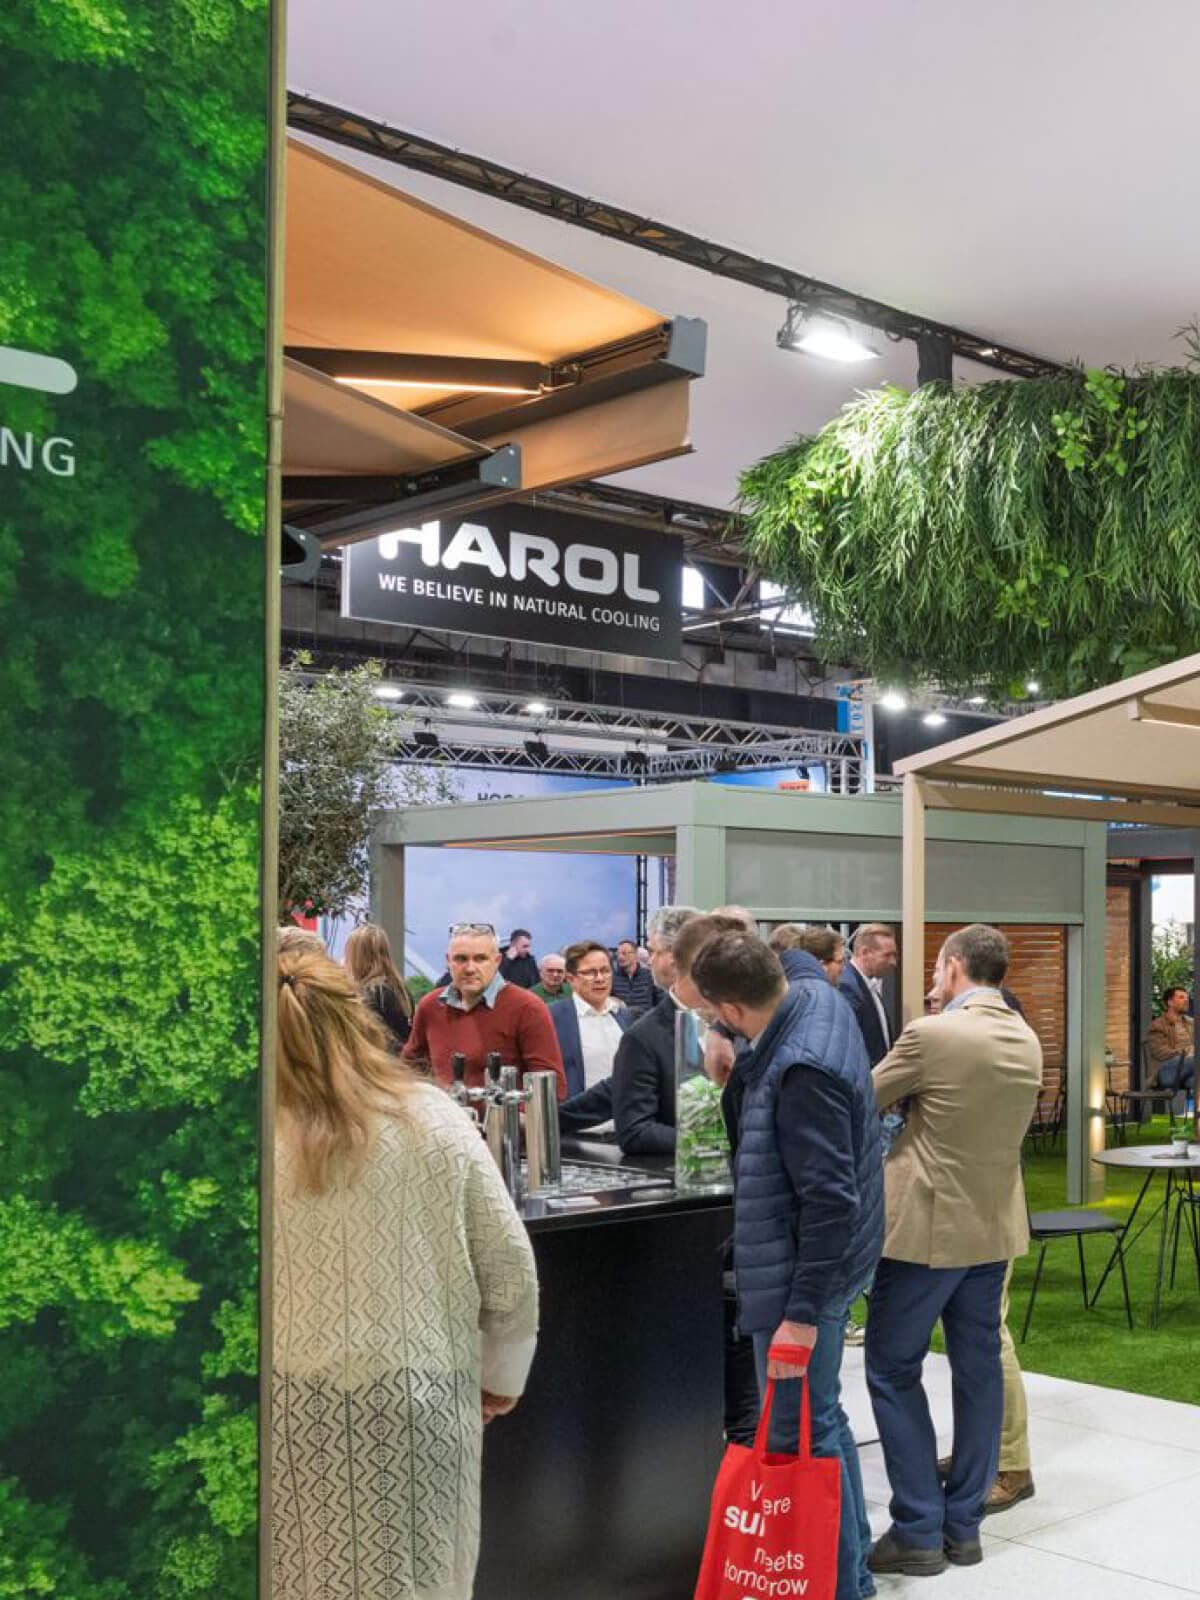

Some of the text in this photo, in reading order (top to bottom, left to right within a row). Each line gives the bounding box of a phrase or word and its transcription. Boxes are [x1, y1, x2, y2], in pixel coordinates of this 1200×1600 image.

[378, 520, 661, 604] HAROL
[378, 572, 660, 632] WE BELIEVE IN NATURAL COOLING
